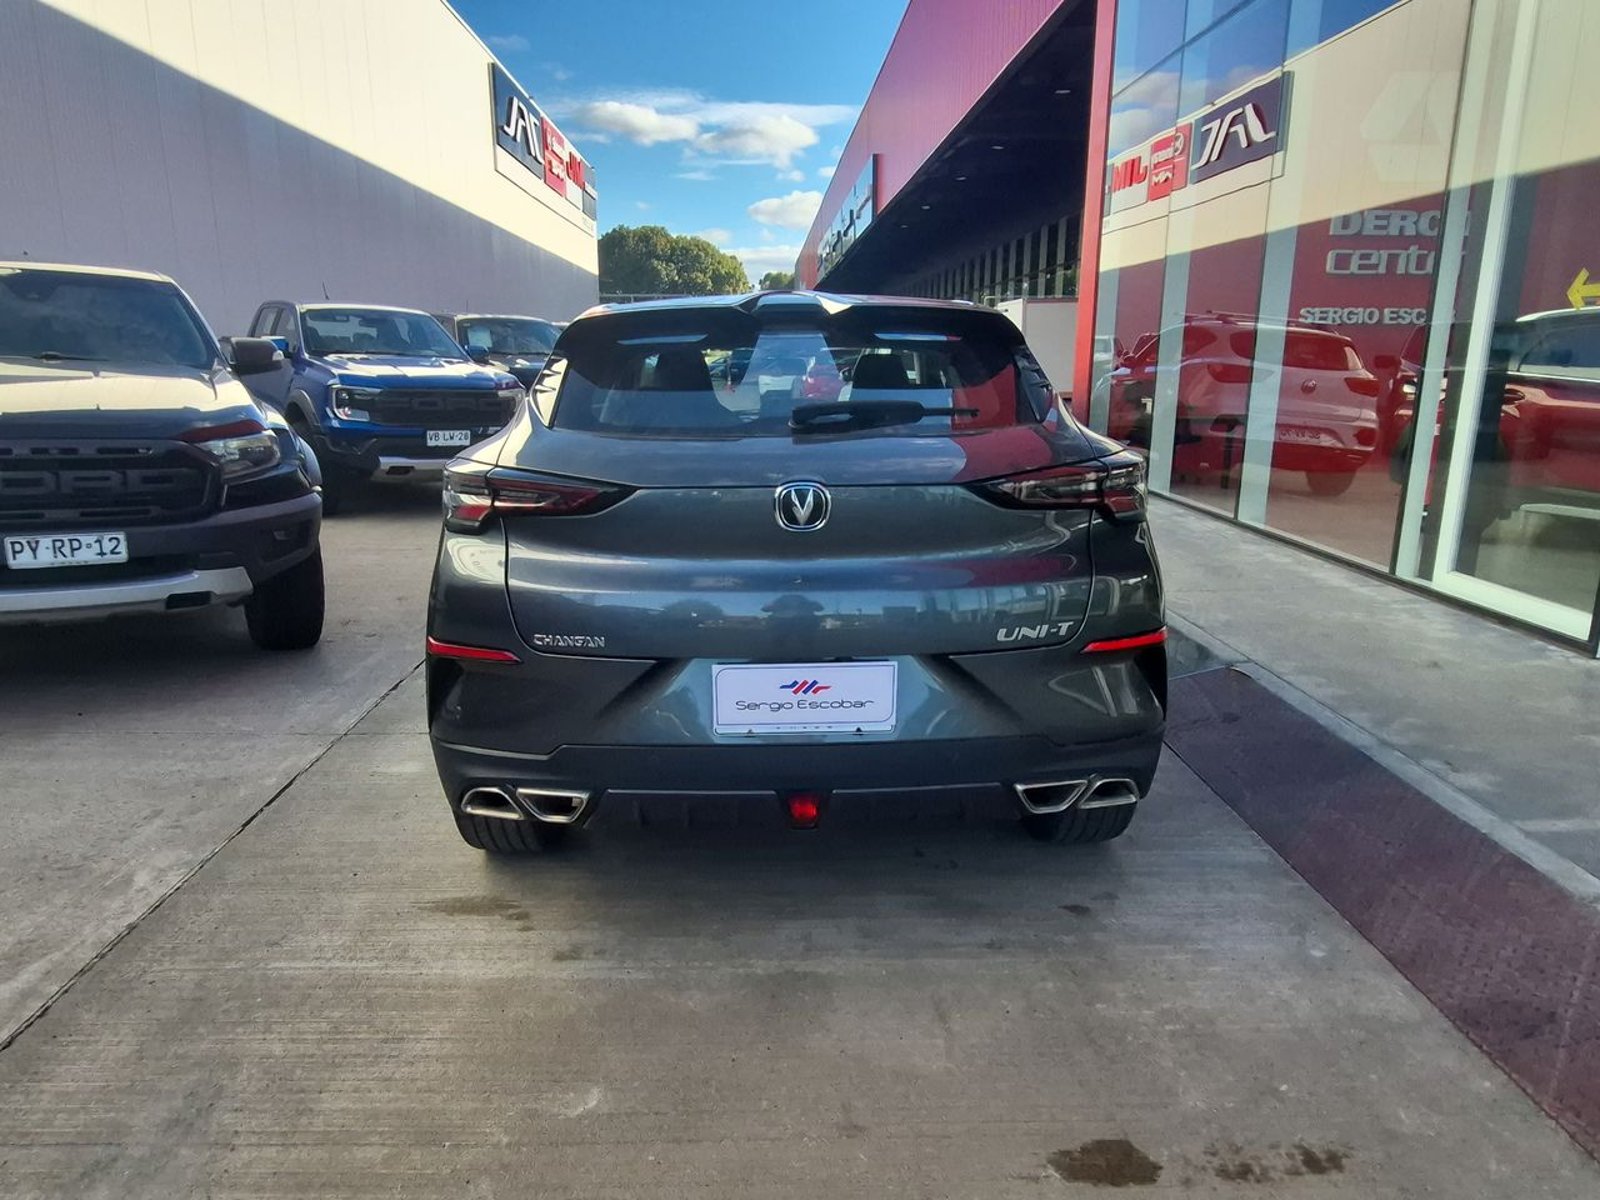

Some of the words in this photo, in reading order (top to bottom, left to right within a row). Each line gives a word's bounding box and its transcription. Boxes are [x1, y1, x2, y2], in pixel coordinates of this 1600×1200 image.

[1329, 210, 1442, 236] DERC
[1326, 245, 1435, 275] cent
[1299, 307, 1379, 325] SERGIO
[1383, 307, 1427, 325] ESC
[533, 634, 605, 647] CHANGAN
[997, 621, 1074, 641] UNI-T
[735, 700, 793, 712] Sergio
[797, 699, 874, 710] Escobar
